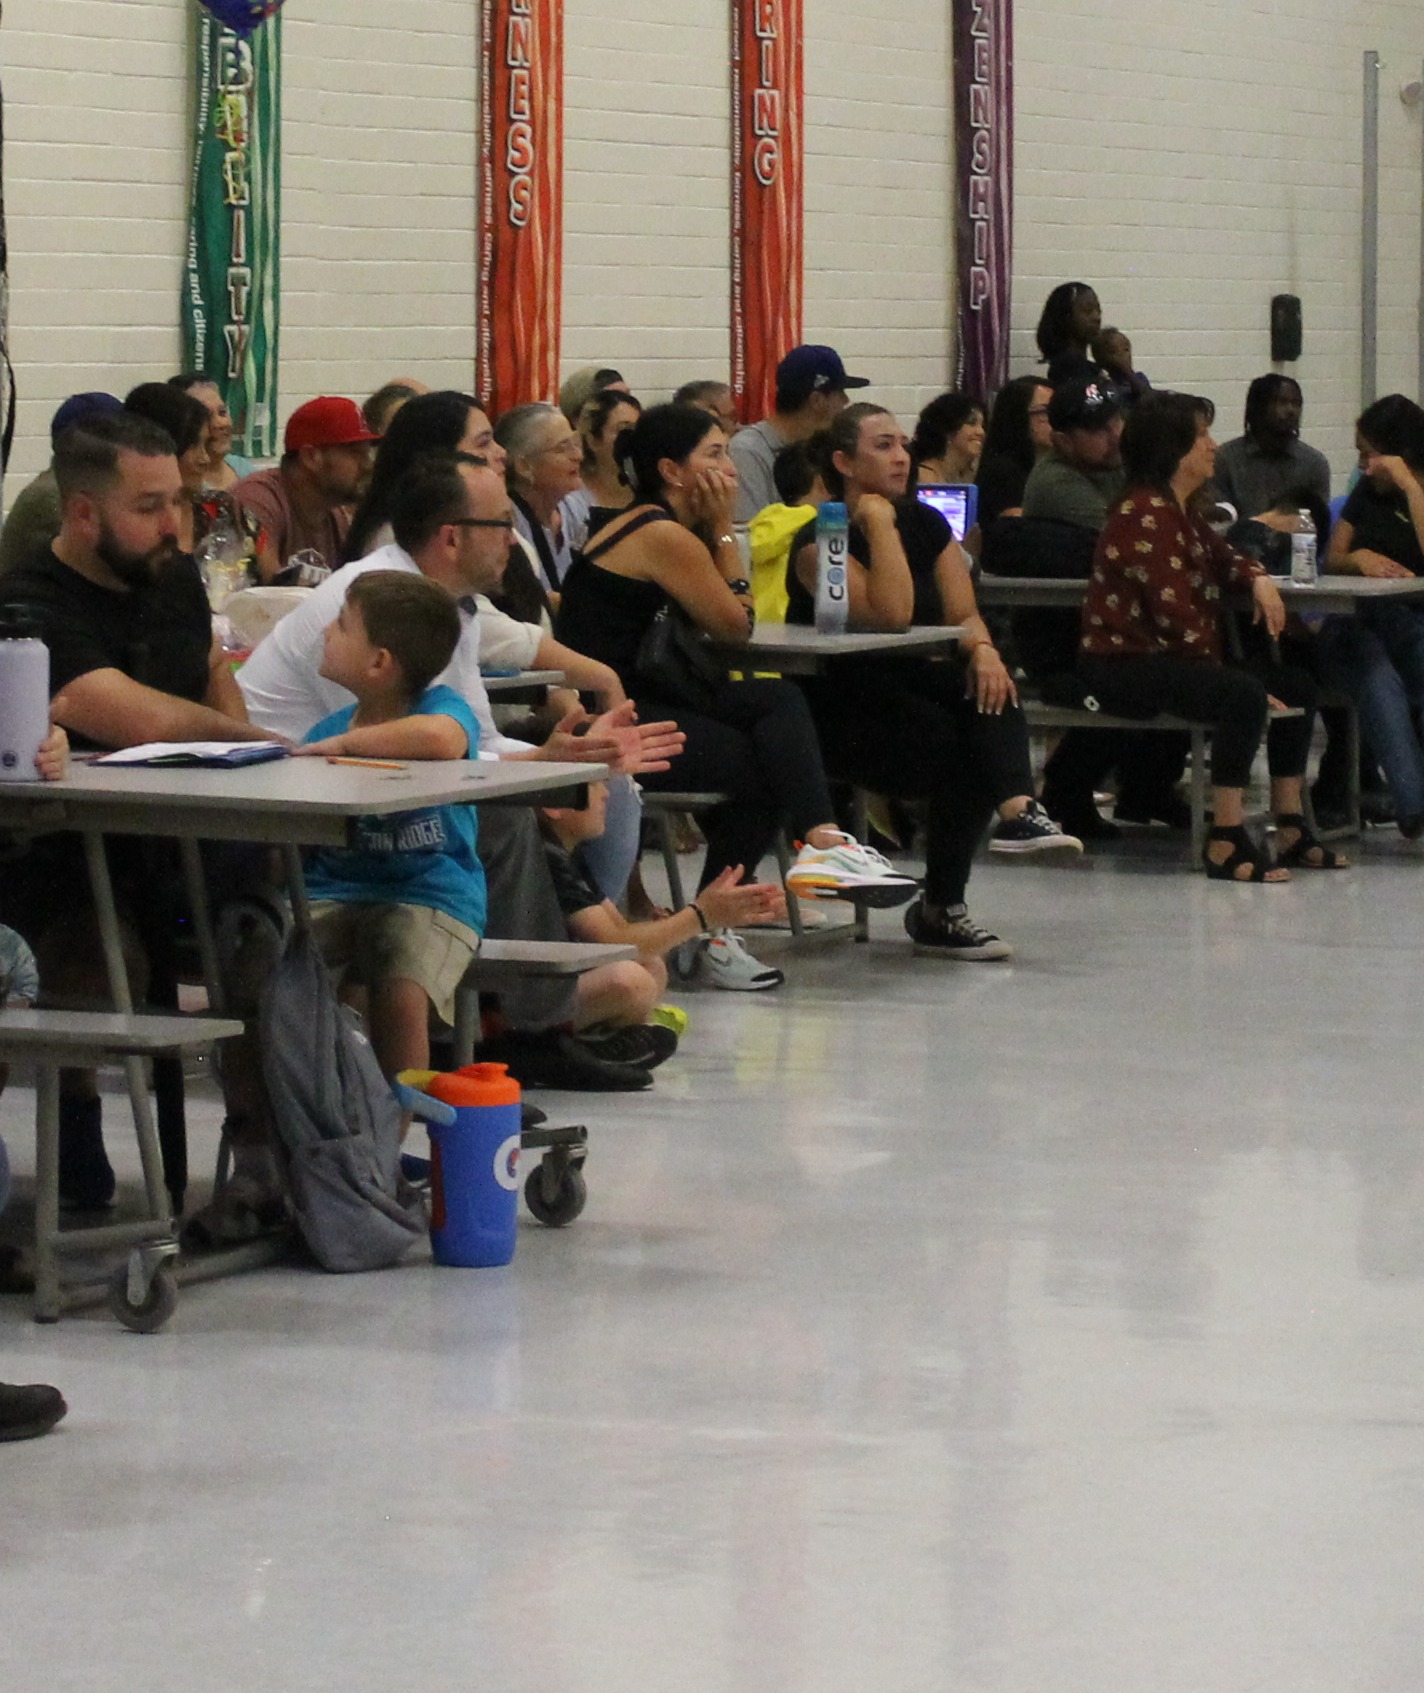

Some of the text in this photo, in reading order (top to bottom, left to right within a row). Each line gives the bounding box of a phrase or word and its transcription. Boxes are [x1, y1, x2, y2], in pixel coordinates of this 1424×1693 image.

[507, 0, 534, 227] NESS
[215, 27, 254, 378] BILITY
[189, 272, 205, 306] and
[827, 537, 845, 601] core
[397, 815, 447, 851] RIDGE
